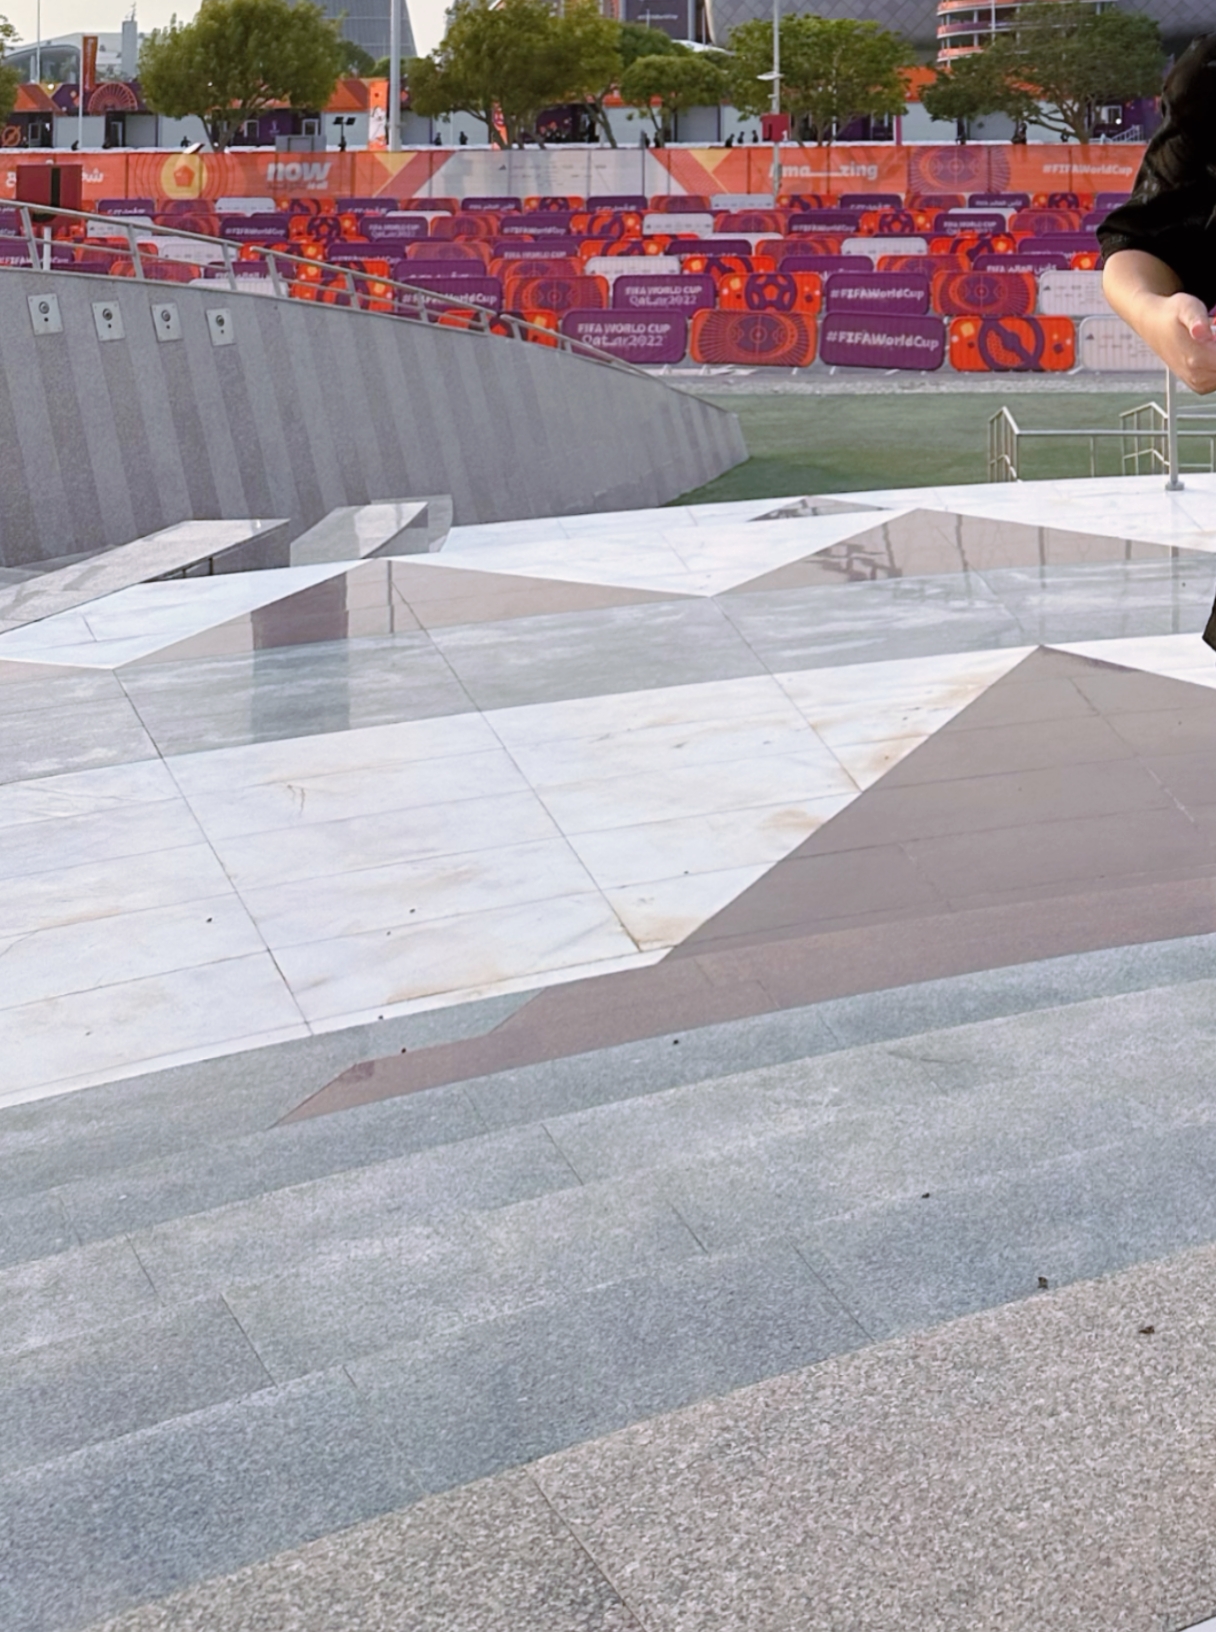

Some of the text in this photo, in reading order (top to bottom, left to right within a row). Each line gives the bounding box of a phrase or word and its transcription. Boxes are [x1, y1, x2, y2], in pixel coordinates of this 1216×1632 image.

[267, 162, 332, 182] now
[1043, 164, 1134, 176] #FIFAWorldCup
[648, 286, 682, 296] WORLD
[683, 285, 703, 295] CUP
[830, 288, 925, 301] #FIFAWorldCup
[629, 295, 697, 307] Qatar2022
[578, 323, 672, 334] FIFA WORLD CUP
[581, 335, 665, 349] Qatar2022
[826, 331, 940, 352] #FIFAWorldCup
